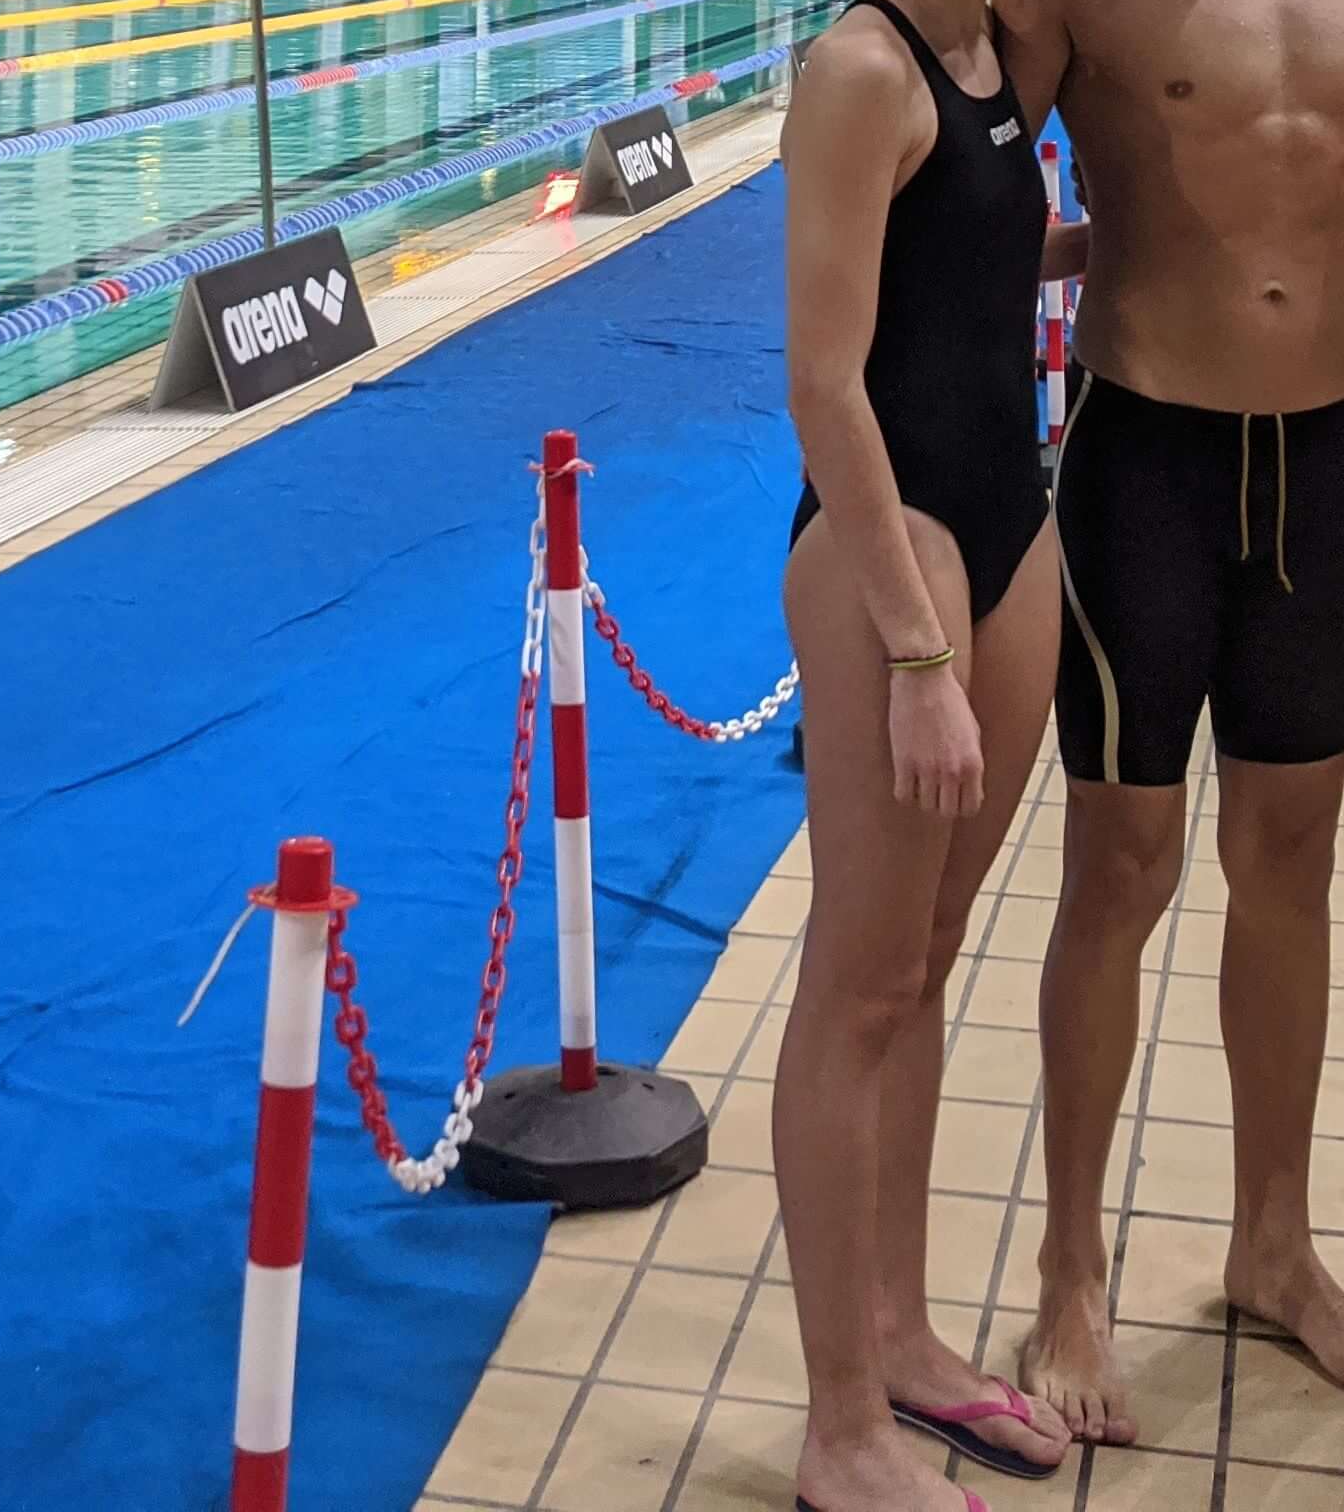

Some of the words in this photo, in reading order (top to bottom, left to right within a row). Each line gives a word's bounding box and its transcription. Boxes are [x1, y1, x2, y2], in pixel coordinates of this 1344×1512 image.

[990, 117, 1021, 146] arena
[616, 139, 657, 187] arena
[221, 286, 309, 366] arena
